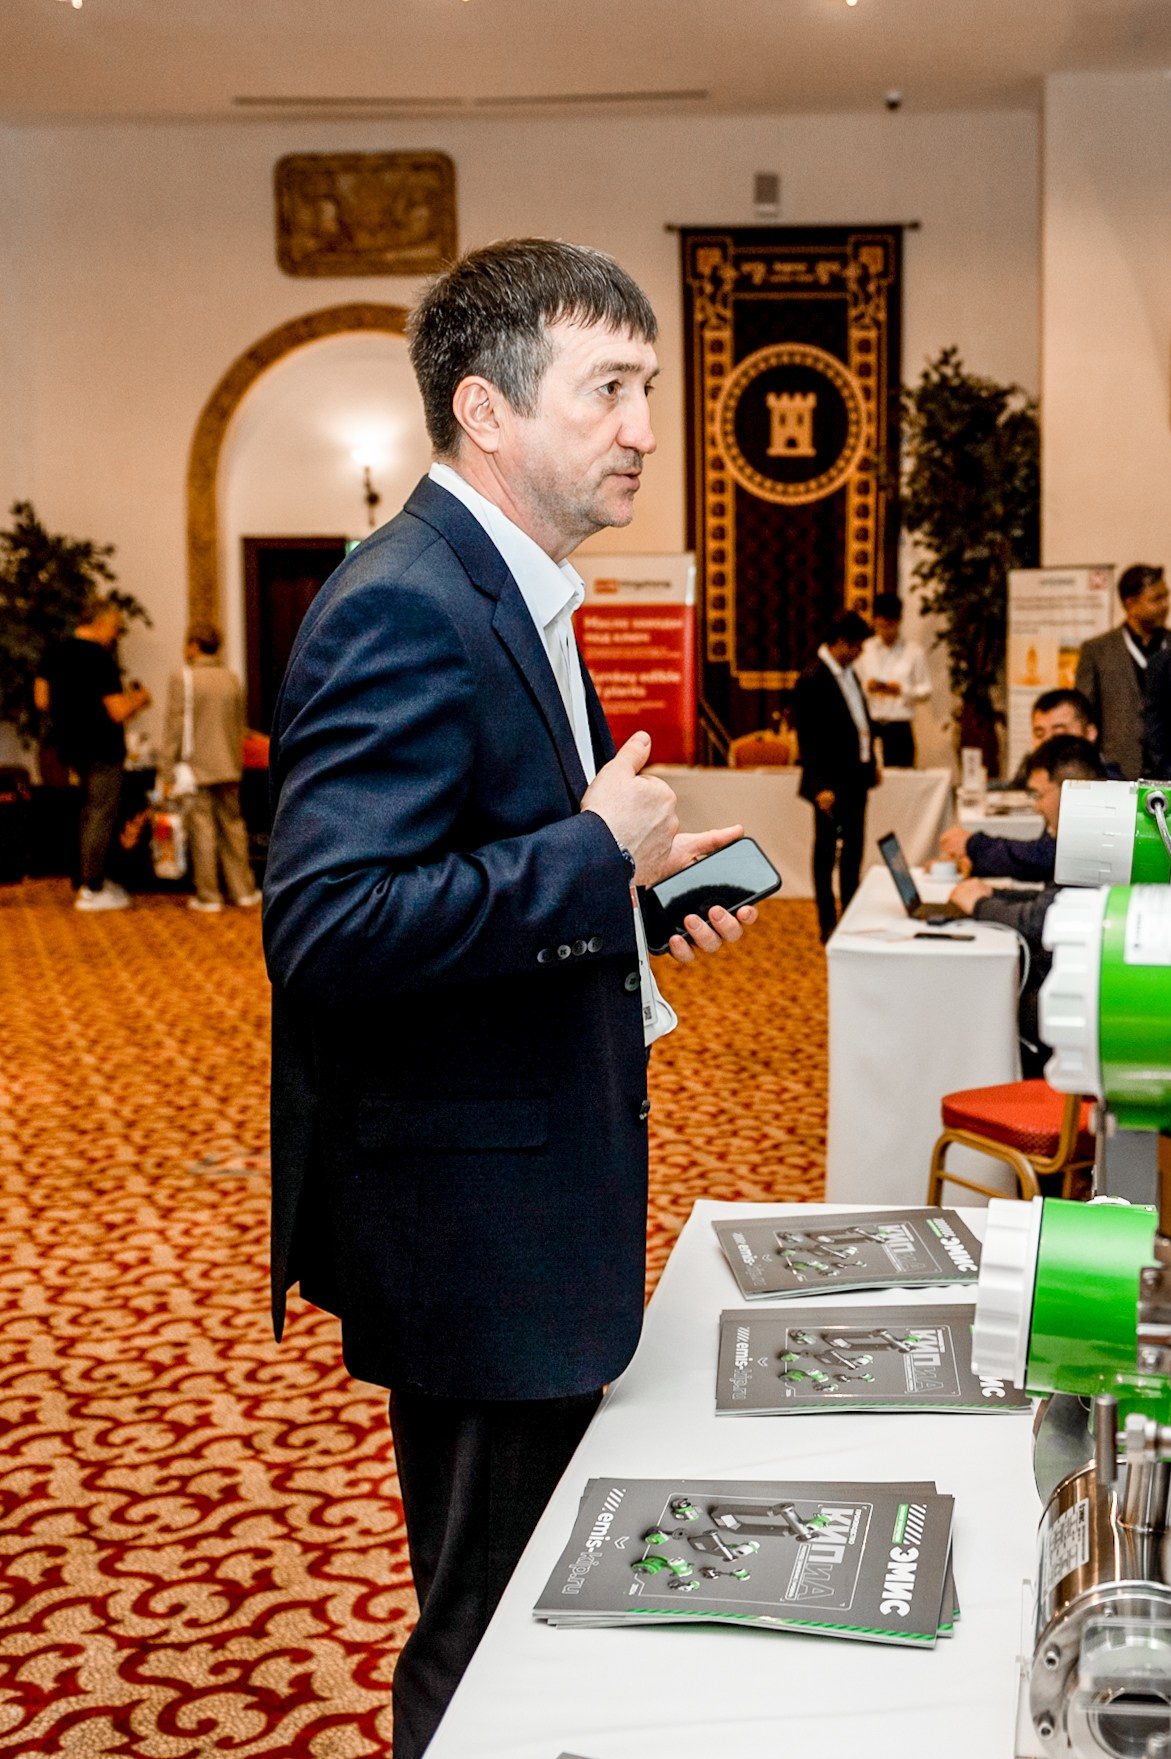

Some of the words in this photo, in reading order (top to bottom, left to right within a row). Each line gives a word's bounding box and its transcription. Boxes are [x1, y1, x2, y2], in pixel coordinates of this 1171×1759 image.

[940, 1237, 978, 1272] ЭМИС
[561, 1512, 614, 1595] emis-kip.ru
[879, 1546, 919, 1617] ЭМИС
